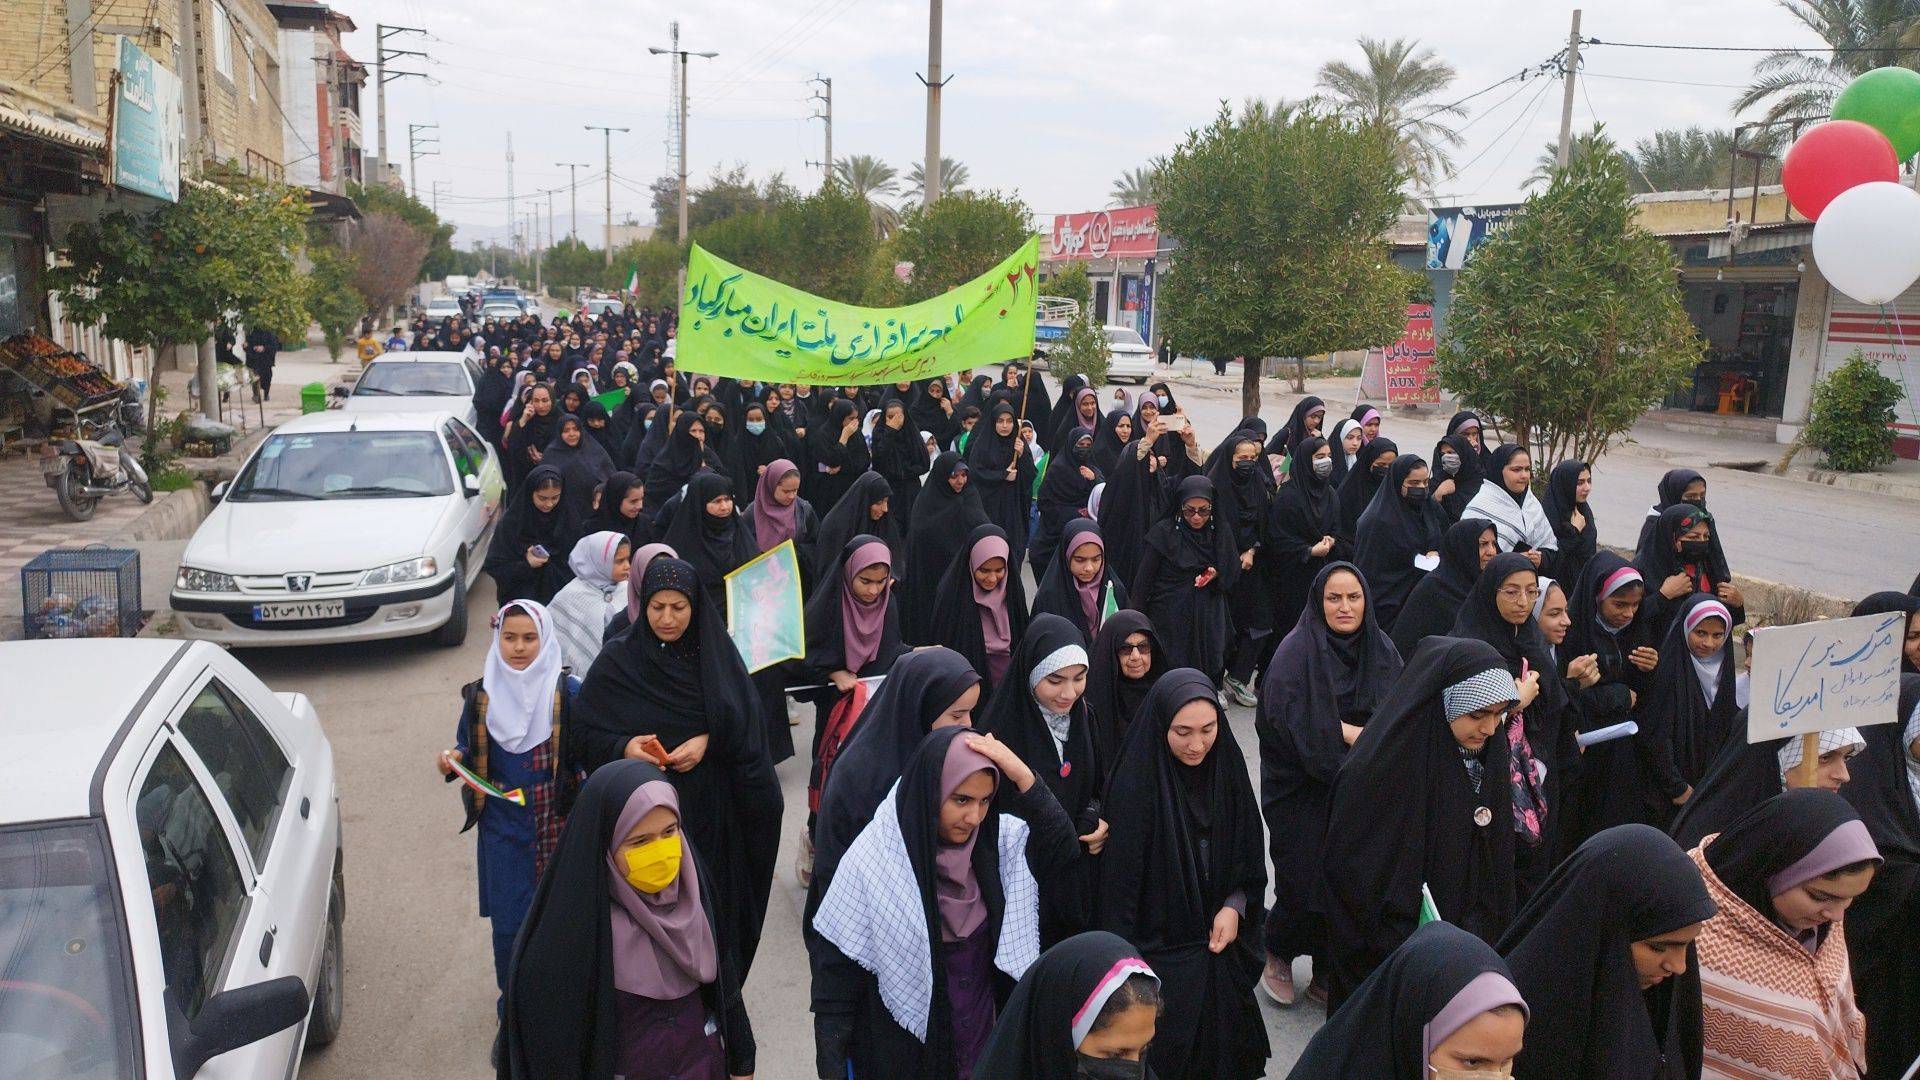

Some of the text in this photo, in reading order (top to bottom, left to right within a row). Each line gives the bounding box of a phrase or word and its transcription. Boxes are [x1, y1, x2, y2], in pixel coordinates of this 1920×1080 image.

[1478, 208, 1501, 220] موبایل
[1051, 215, 1090, 257] کوروش
[1006, 262, 1036, 306] ۲۲
[740, 302, 798, 359] ایران
[1411, 326, 1434, 341] لوازم
[1385, 342, 1436, 363] موبایل
[1389, 377, 1416, 388] AUX
[1811, 615, 1901, 668] مرگ بر
[1773, 636, 1825, 729] امریکا
